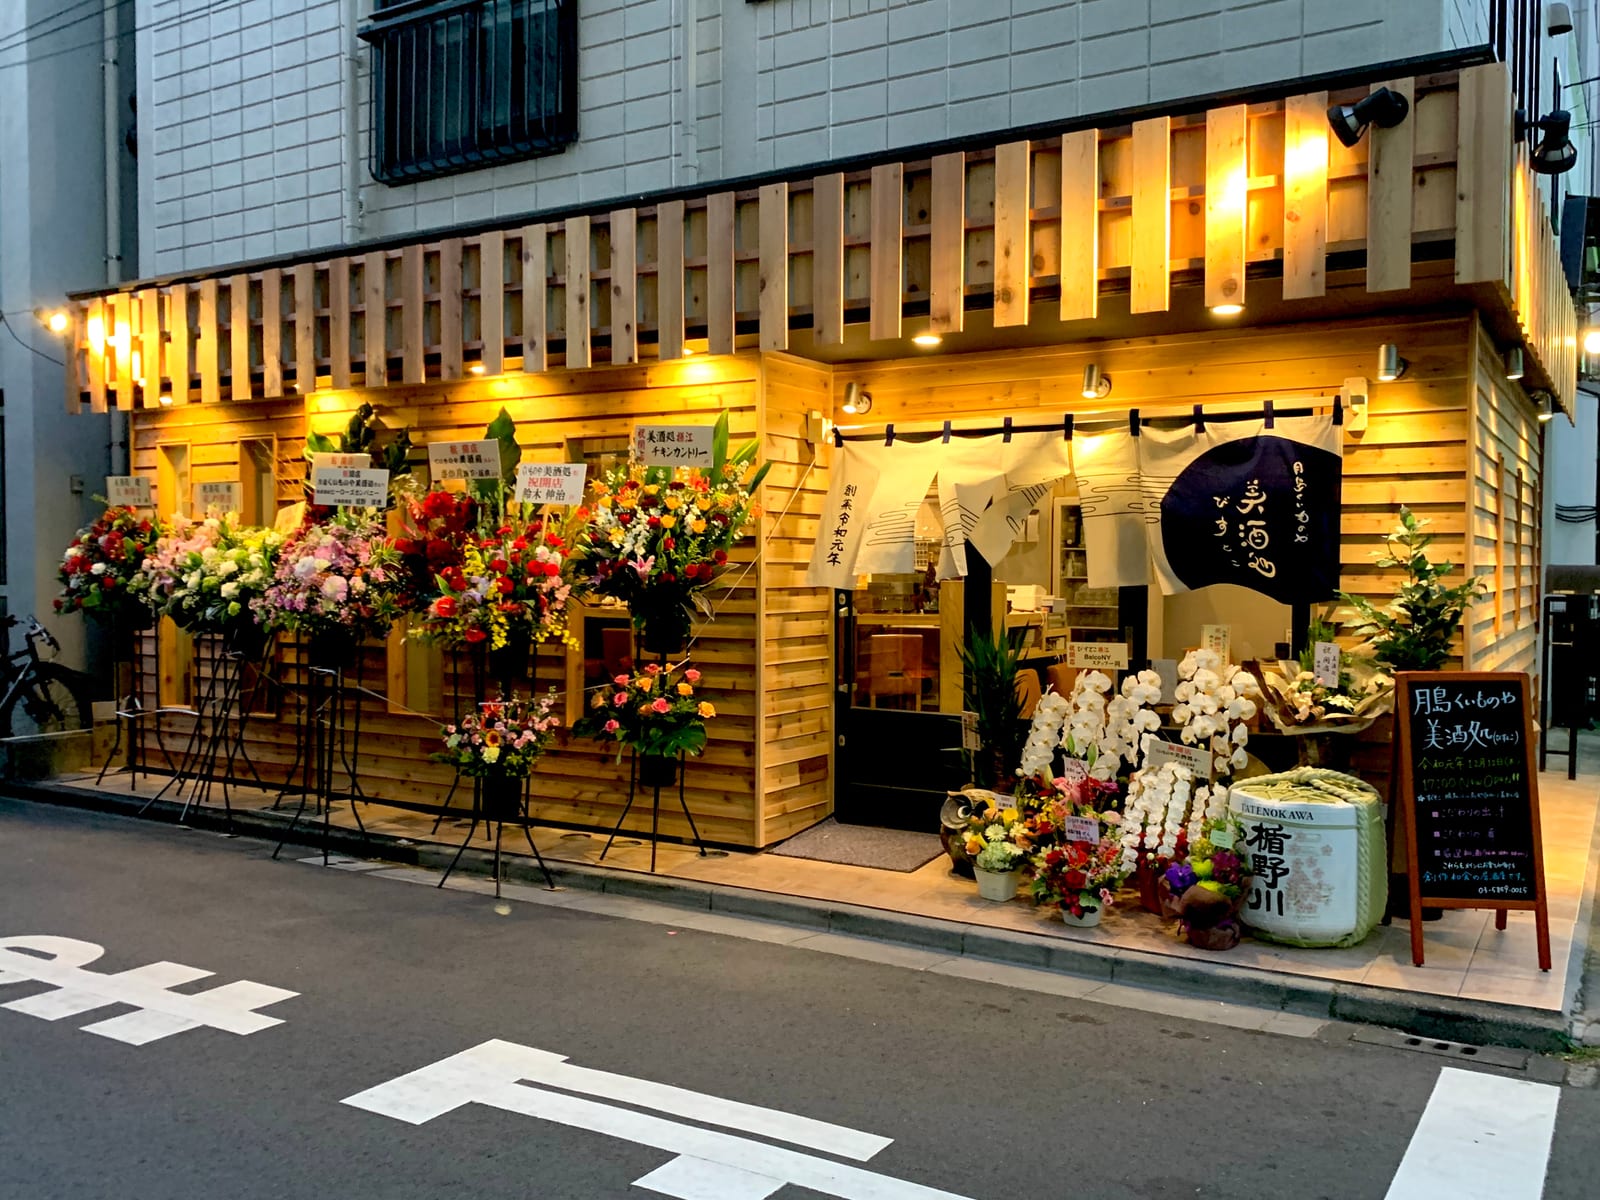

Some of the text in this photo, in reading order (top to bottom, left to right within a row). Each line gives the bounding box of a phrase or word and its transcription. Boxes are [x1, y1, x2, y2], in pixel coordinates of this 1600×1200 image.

[647, 430, 675, 443] 美酒処
[651, 446, 708, 459] チキンカントリー
[1236, 479, 1276, 578] 美酒処
[1414, 686, 1516, 716] 月島くいものや
[1241, 802, 1314, 821] TATENOKAWA
[1246, 822, 1292, 916] 楯野川
